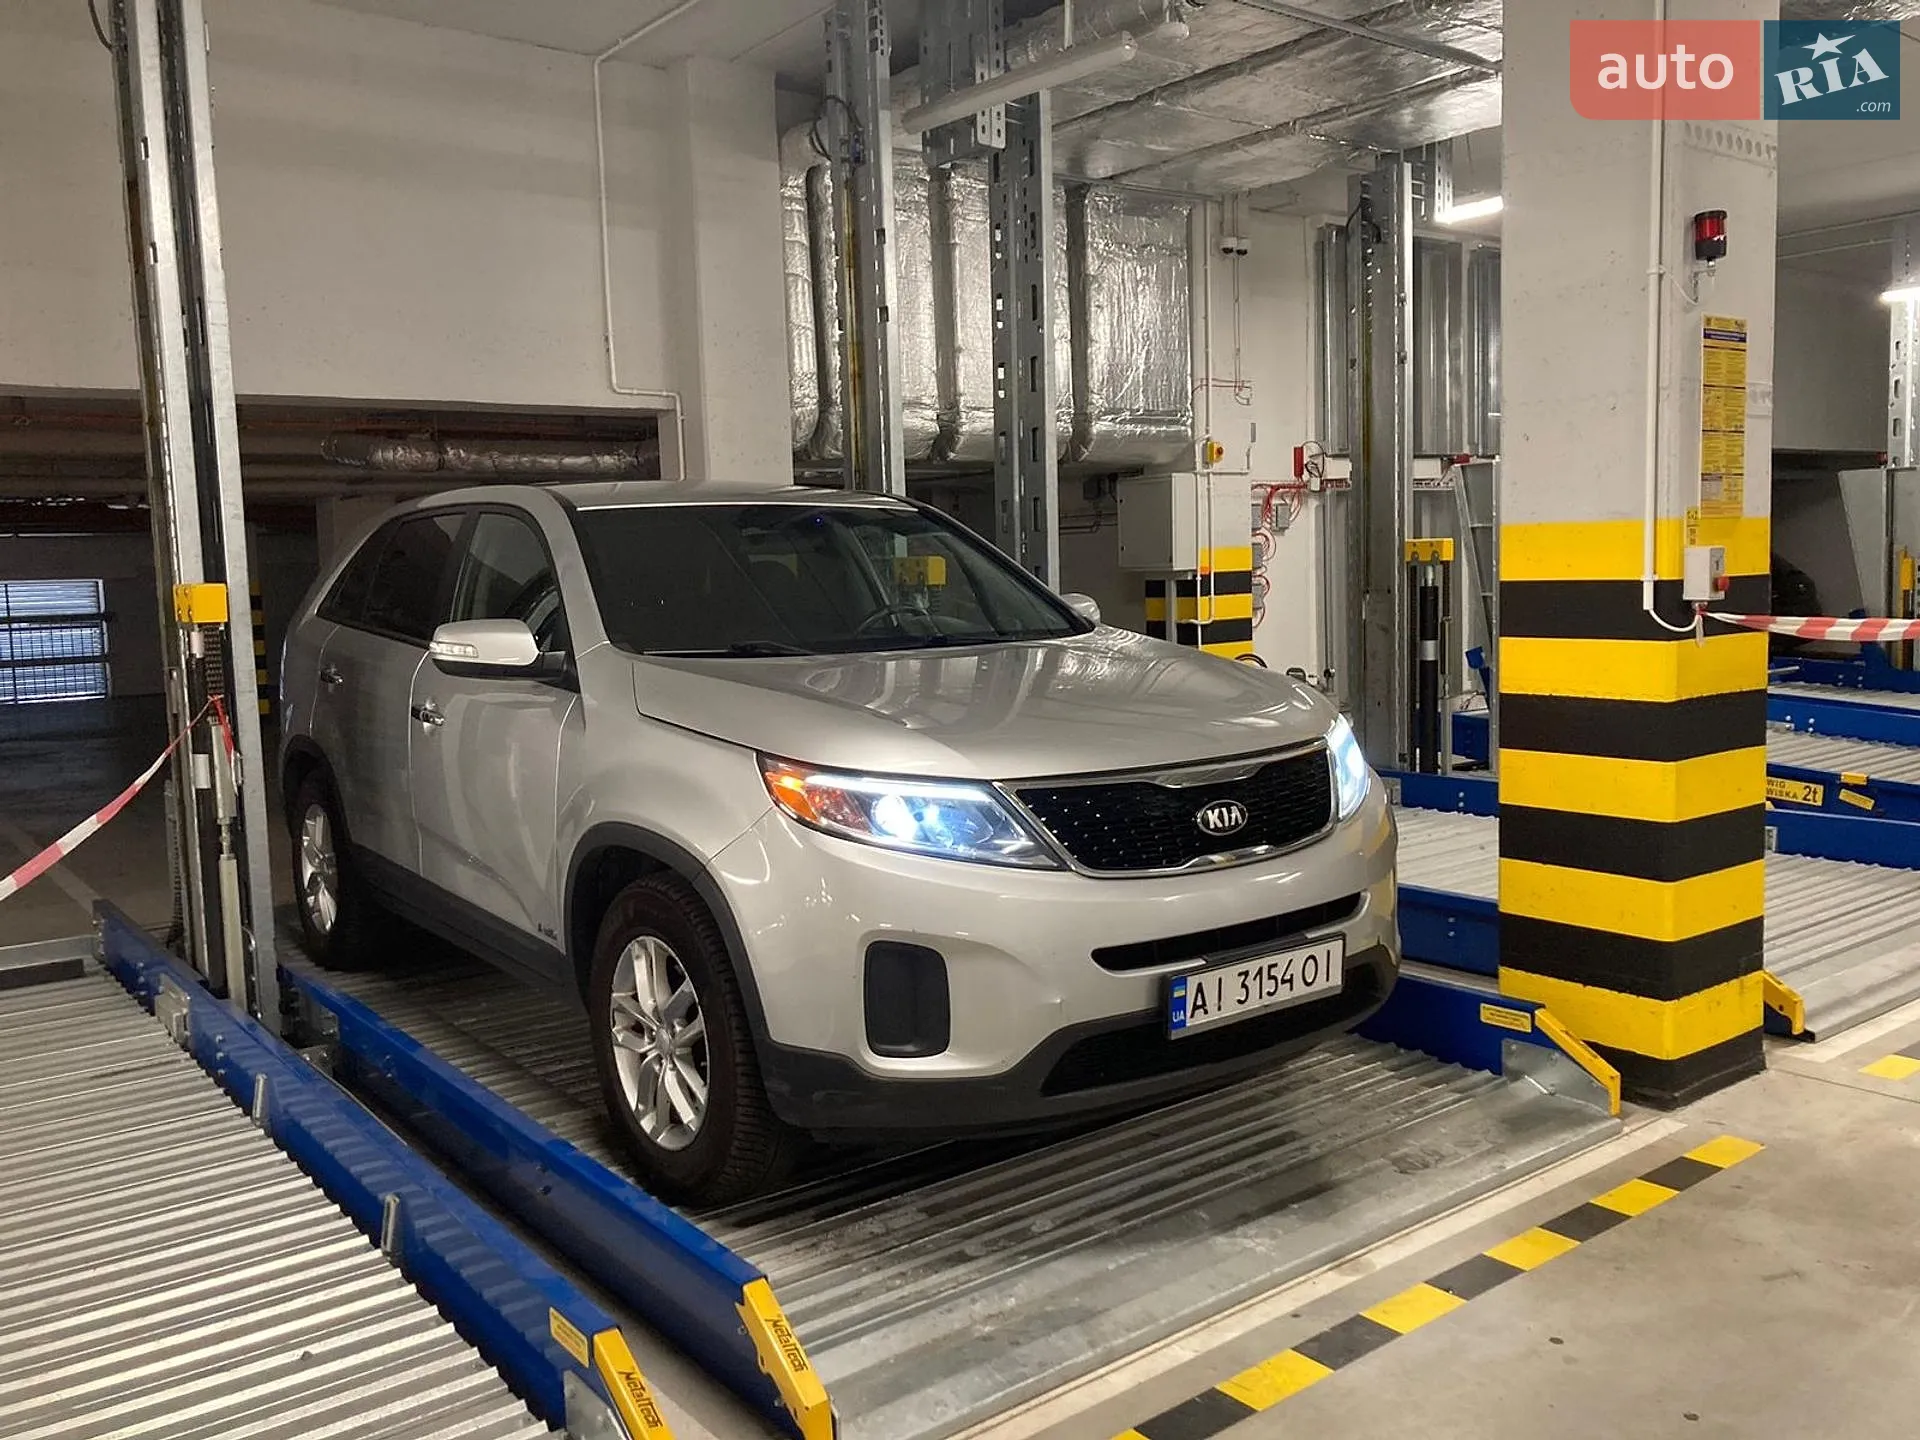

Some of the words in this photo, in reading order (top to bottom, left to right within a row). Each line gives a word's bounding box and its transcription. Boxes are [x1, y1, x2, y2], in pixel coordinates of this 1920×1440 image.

[1803, 785, 1818, 803] 2t
[1206, 805, 1242, 829] KIA
[1190, 977, 1222, 1018] AI
[1236, 958, 1294, 1005] 3154
[1301, 950, 1331, 987] OI
[1172, 1011, 1185, 1023] UA
